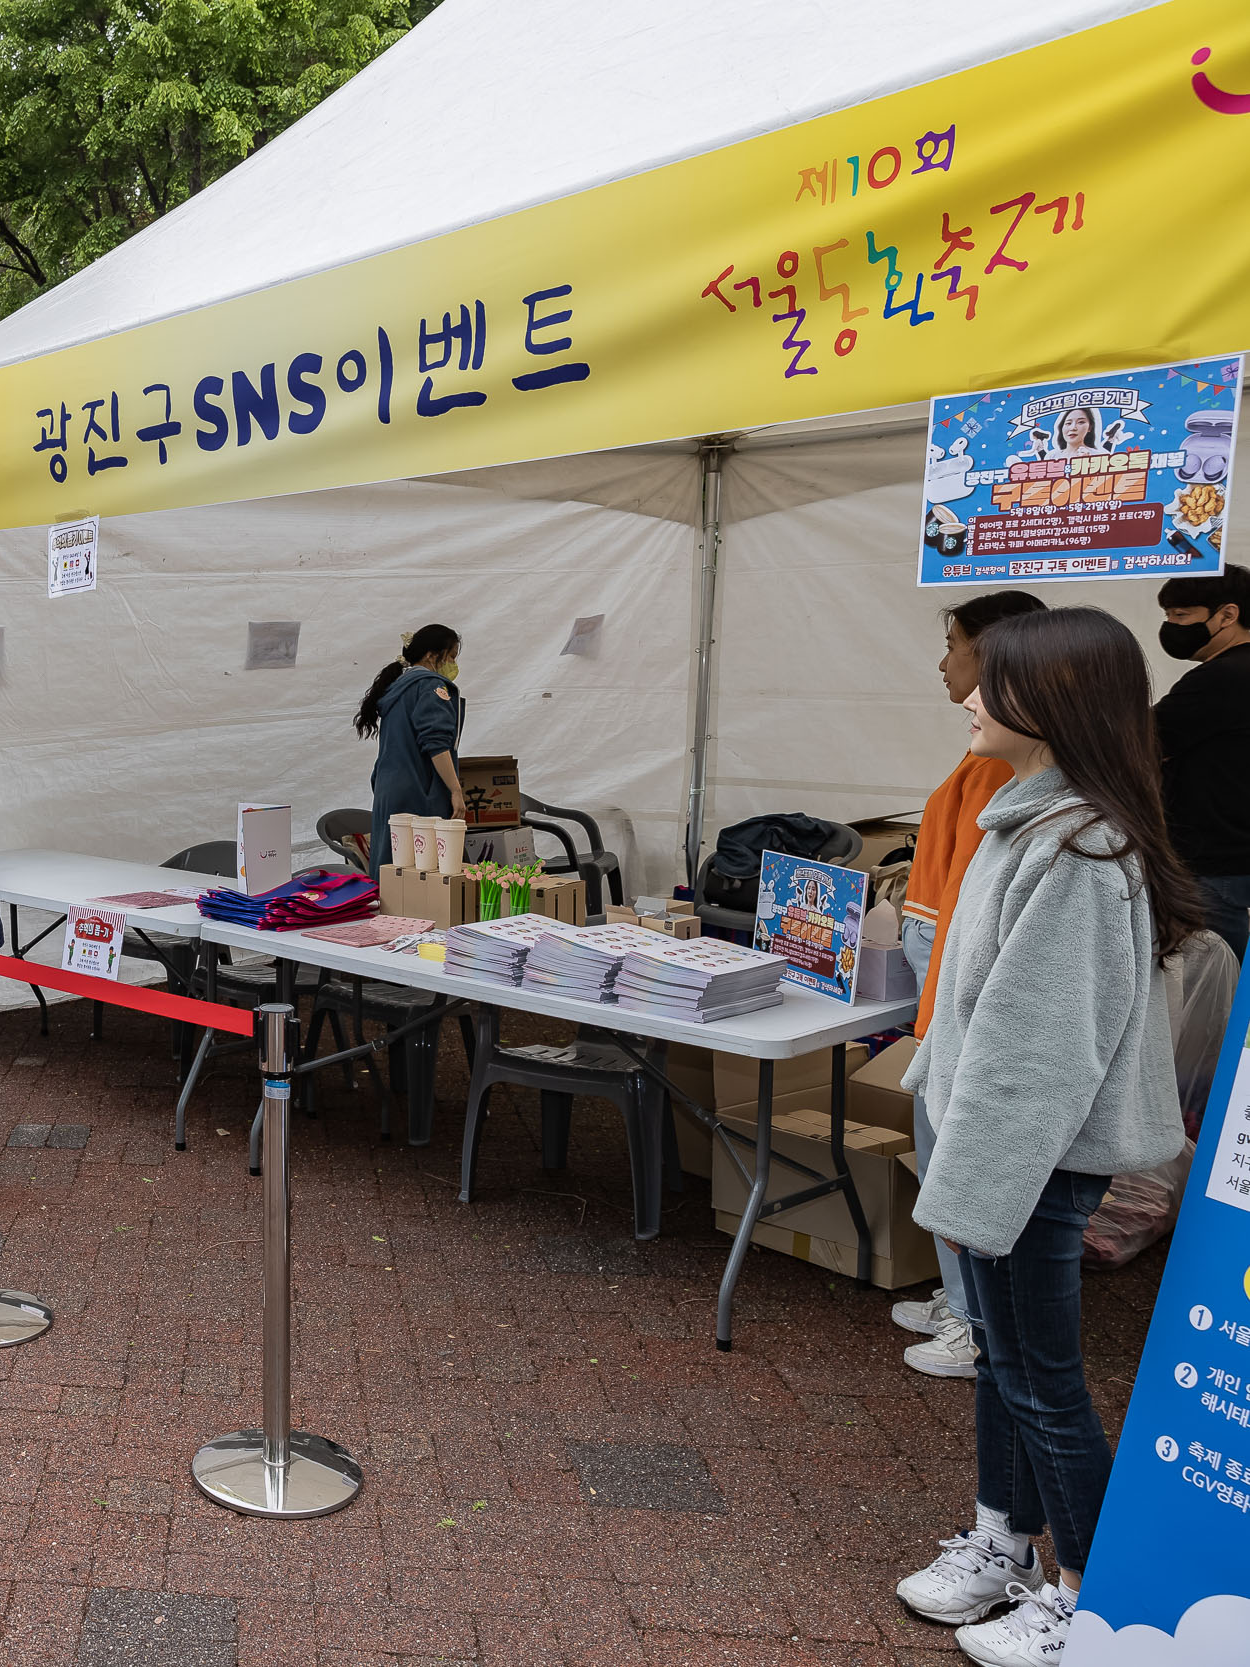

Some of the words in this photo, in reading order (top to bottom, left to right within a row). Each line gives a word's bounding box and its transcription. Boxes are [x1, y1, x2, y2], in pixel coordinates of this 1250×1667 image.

[795, 124, 956, 206] 제10회
[1078, 391, 1104, 405] 오픈
[1107, 389, 1134, 405] 기념
[965, 468, 1010, 486] 광진구
[1005, 518, 1019, 528] 프로
[1066, 515, 1091, 526] 갤럭시
[1092, 513, 1109, 522] 버즈
[1110, 512, 1117, 521] 2
[1009, 507, 1024, 517] 5월
[1025, 505, 1057, 516] 8일(월)
[1068, 503, 1083, 513] 5월
[1084, 500, 1122, 512] 21일(일)
[942, 564, 972, 578] 유튜브
[974, 566, 1007, 577] 검색창에
[1011, 561, 1044, 575] 광진구
[1047, 560, 1068, 572] 구독
[1071, 557, 1108, 571] 이벤트
[1122, 553, 1192, 570] 검색하세요!
[464, 785, 494, 824] 辛
[1206, 1366, 1241, 1396] 개인
[1200, 1391, 1250, 1429] 해시태
[1187, 1440, 1223, 1472] 축제
